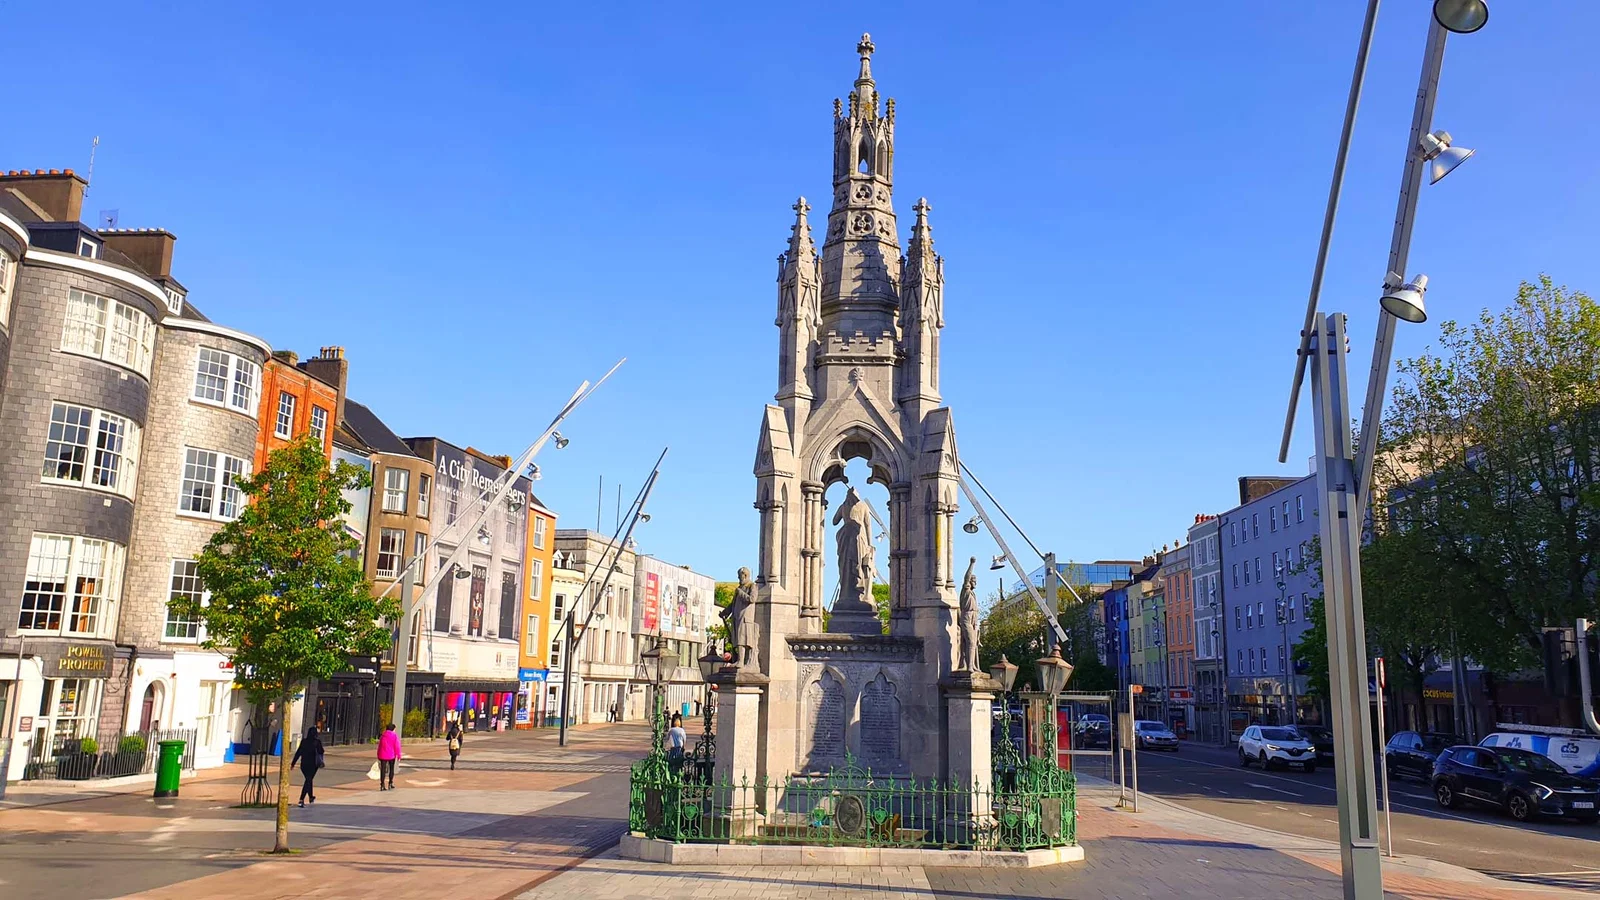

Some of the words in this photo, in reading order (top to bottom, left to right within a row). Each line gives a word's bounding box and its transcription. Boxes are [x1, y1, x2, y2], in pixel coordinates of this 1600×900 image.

[438, 455, 447, 475] A
[449, 459, 471, 488] City
[67, 646, 105, 658] POWELL
